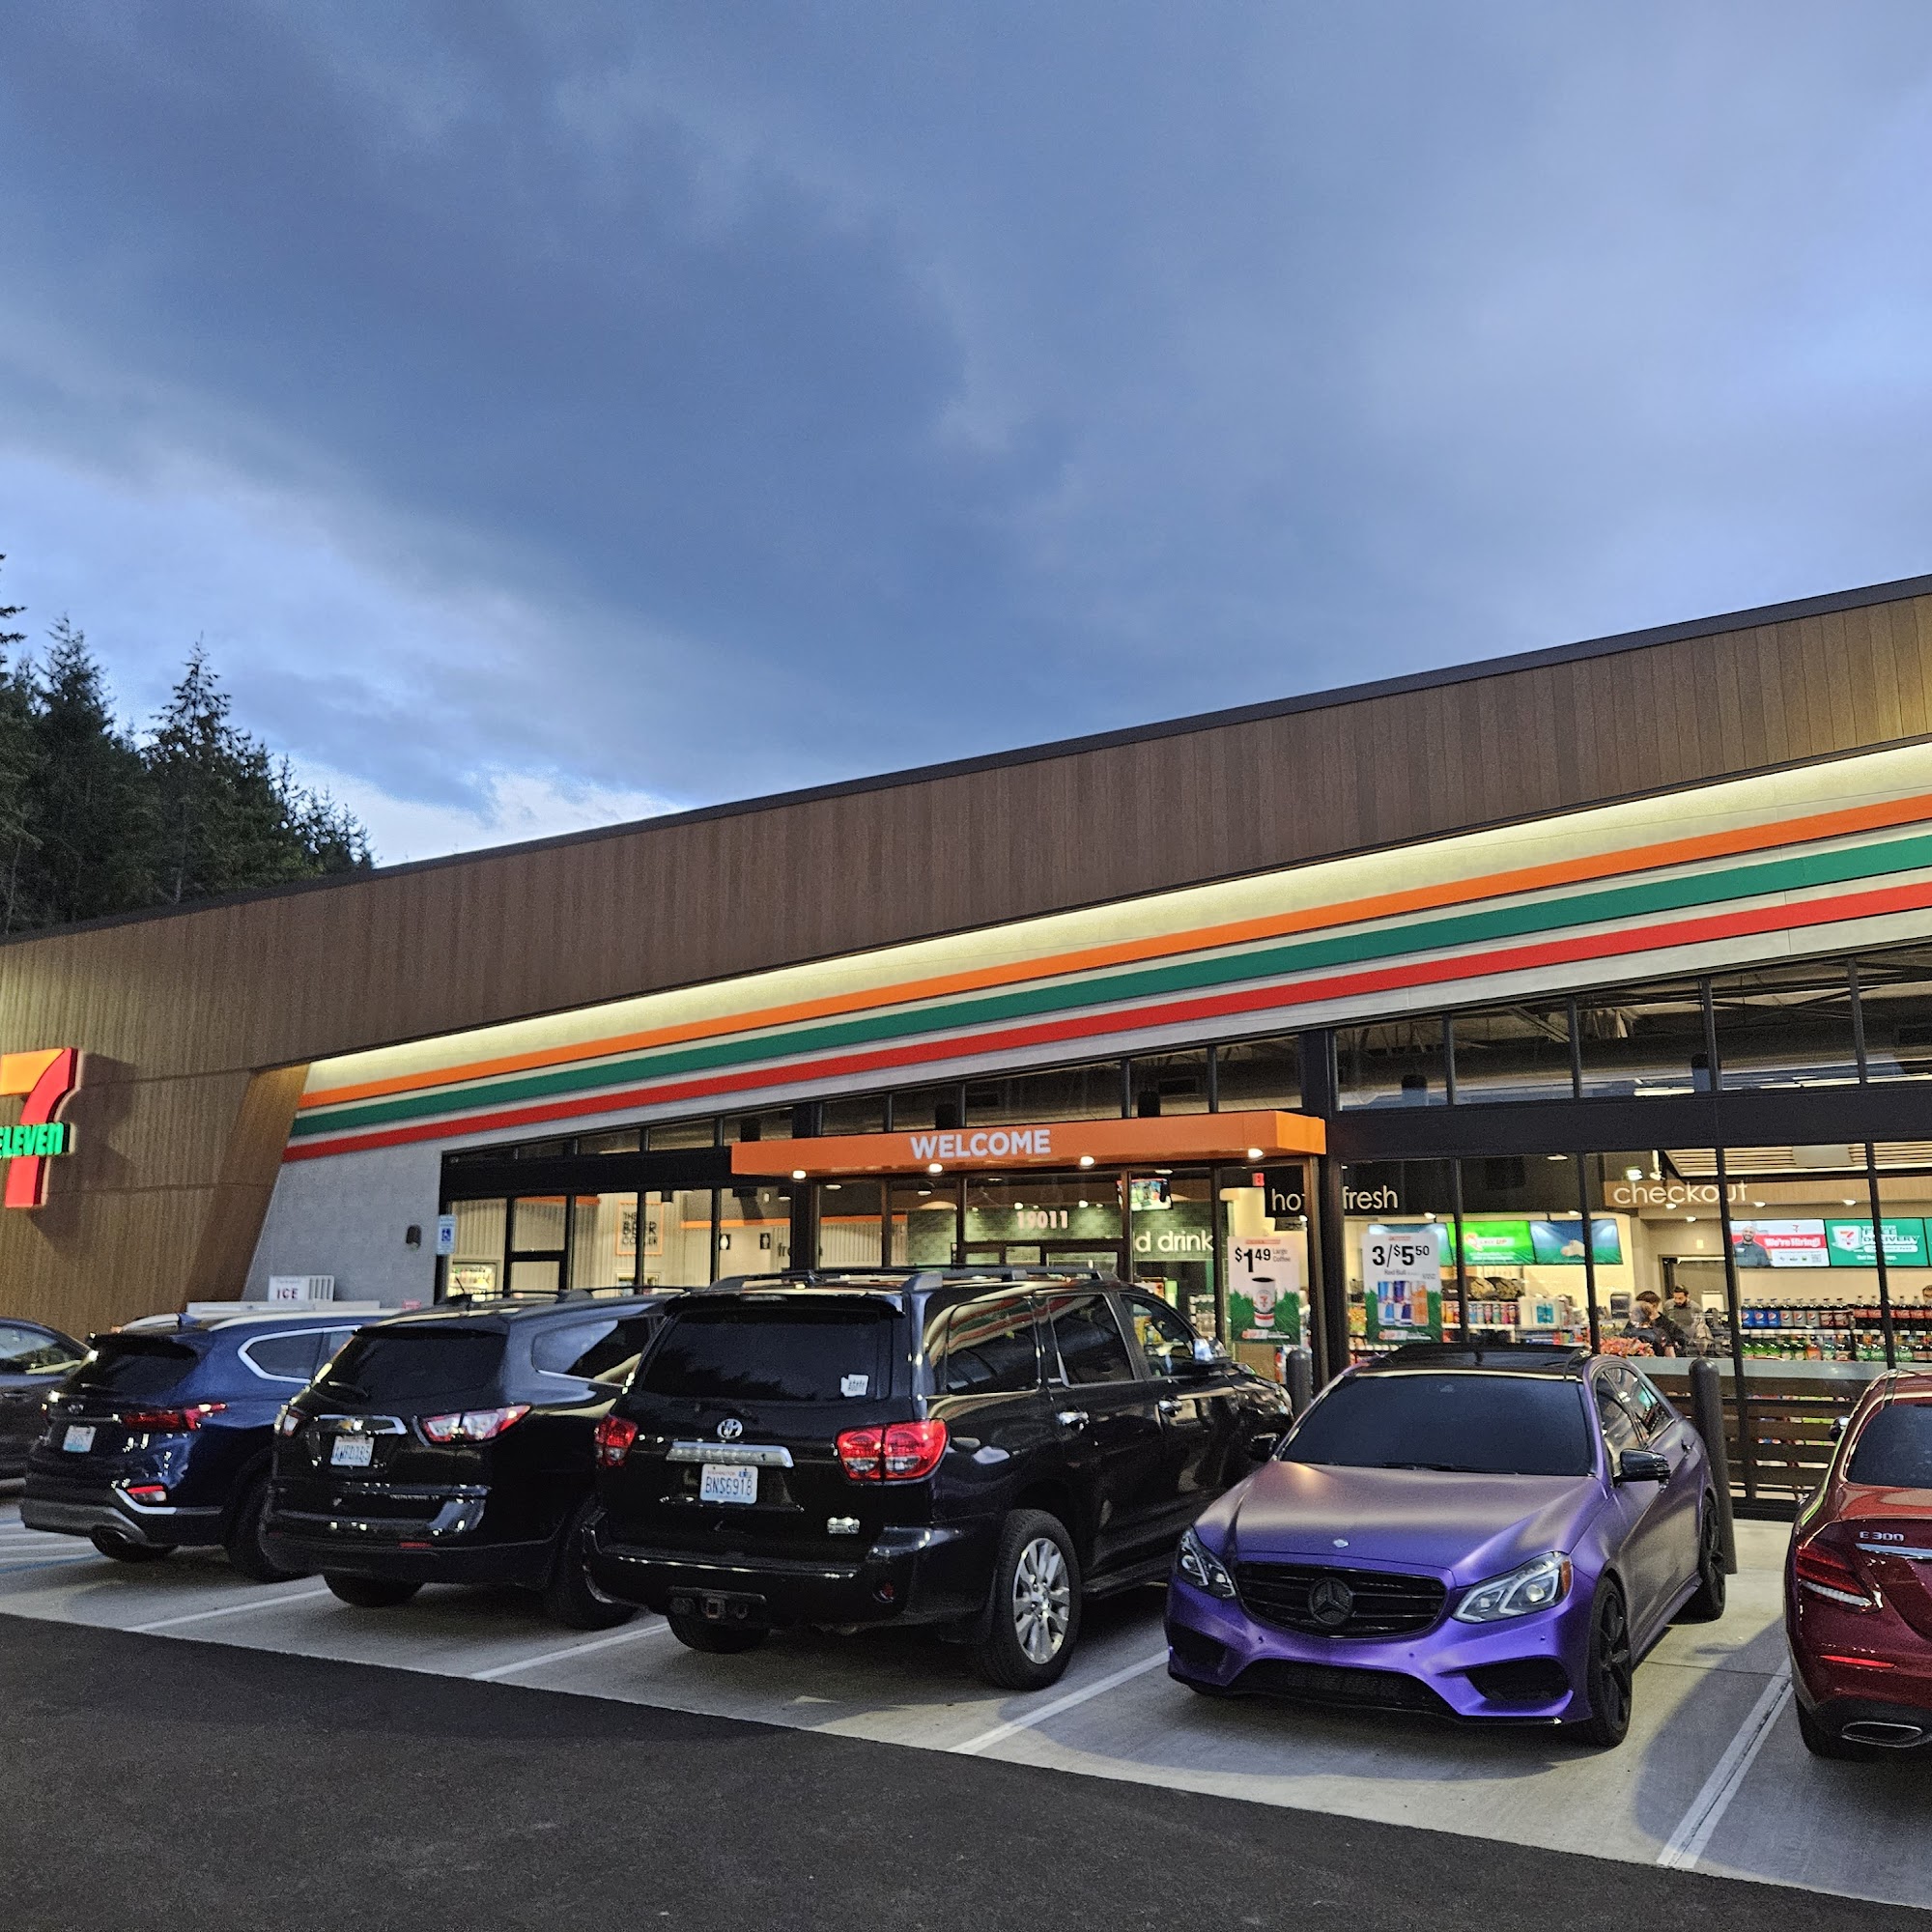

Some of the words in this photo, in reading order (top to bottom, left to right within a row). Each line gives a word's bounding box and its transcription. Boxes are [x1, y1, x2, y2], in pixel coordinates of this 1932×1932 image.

[910, 1129, 1051, 1159] WELCOME
[1271, 1188, 1306, 1211] ho
[1343, 1184, 1399, 1209] fresh
[1613, 1179, 1747, 1204] checkout
[1017, 1210, 1068, 1229] 19011
[276, 1288, 299, 1300] ICE
[705, 1475, 753, 1496] BNS6918
[1859, 1530, 1870, 1539] E
[1871, 1531, 1905, 1542] 300
